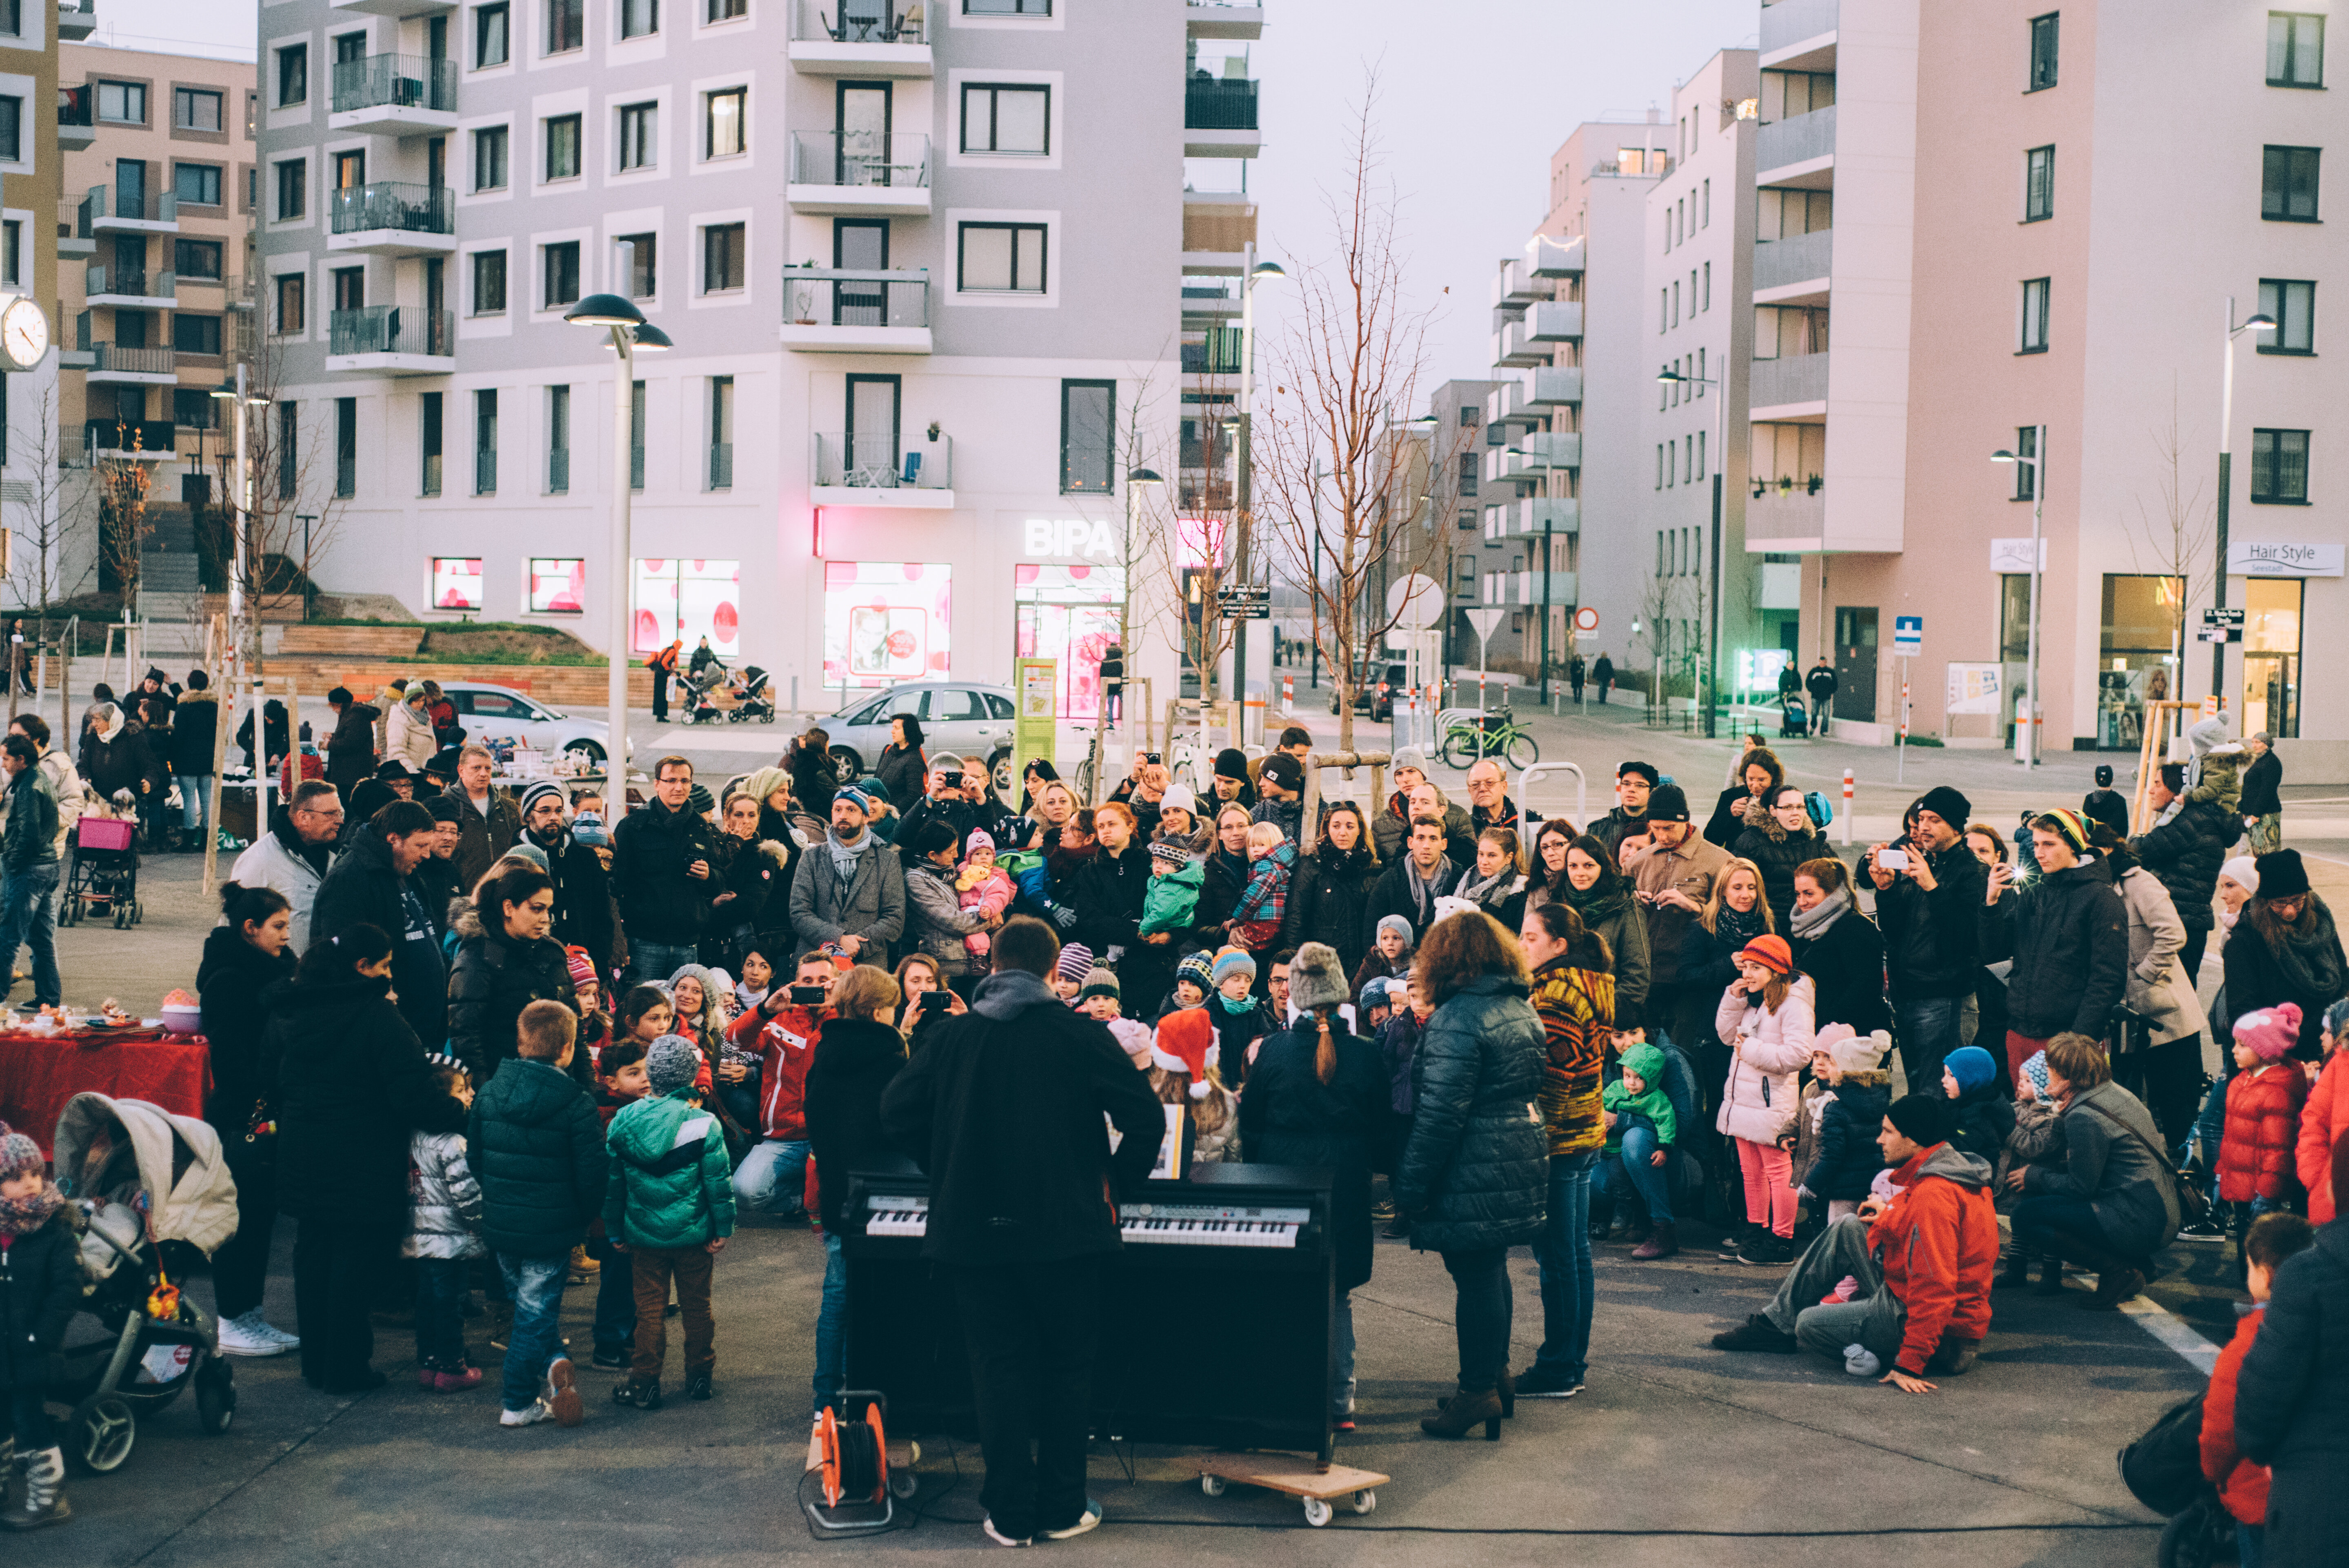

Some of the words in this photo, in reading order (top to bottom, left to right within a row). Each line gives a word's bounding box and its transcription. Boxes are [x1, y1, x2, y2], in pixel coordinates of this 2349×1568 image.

[1025, 520, 1117, 557] BIPA
[2250, 545, 2278, 558] Hair
[2282, 545, 2315, 562] Style
